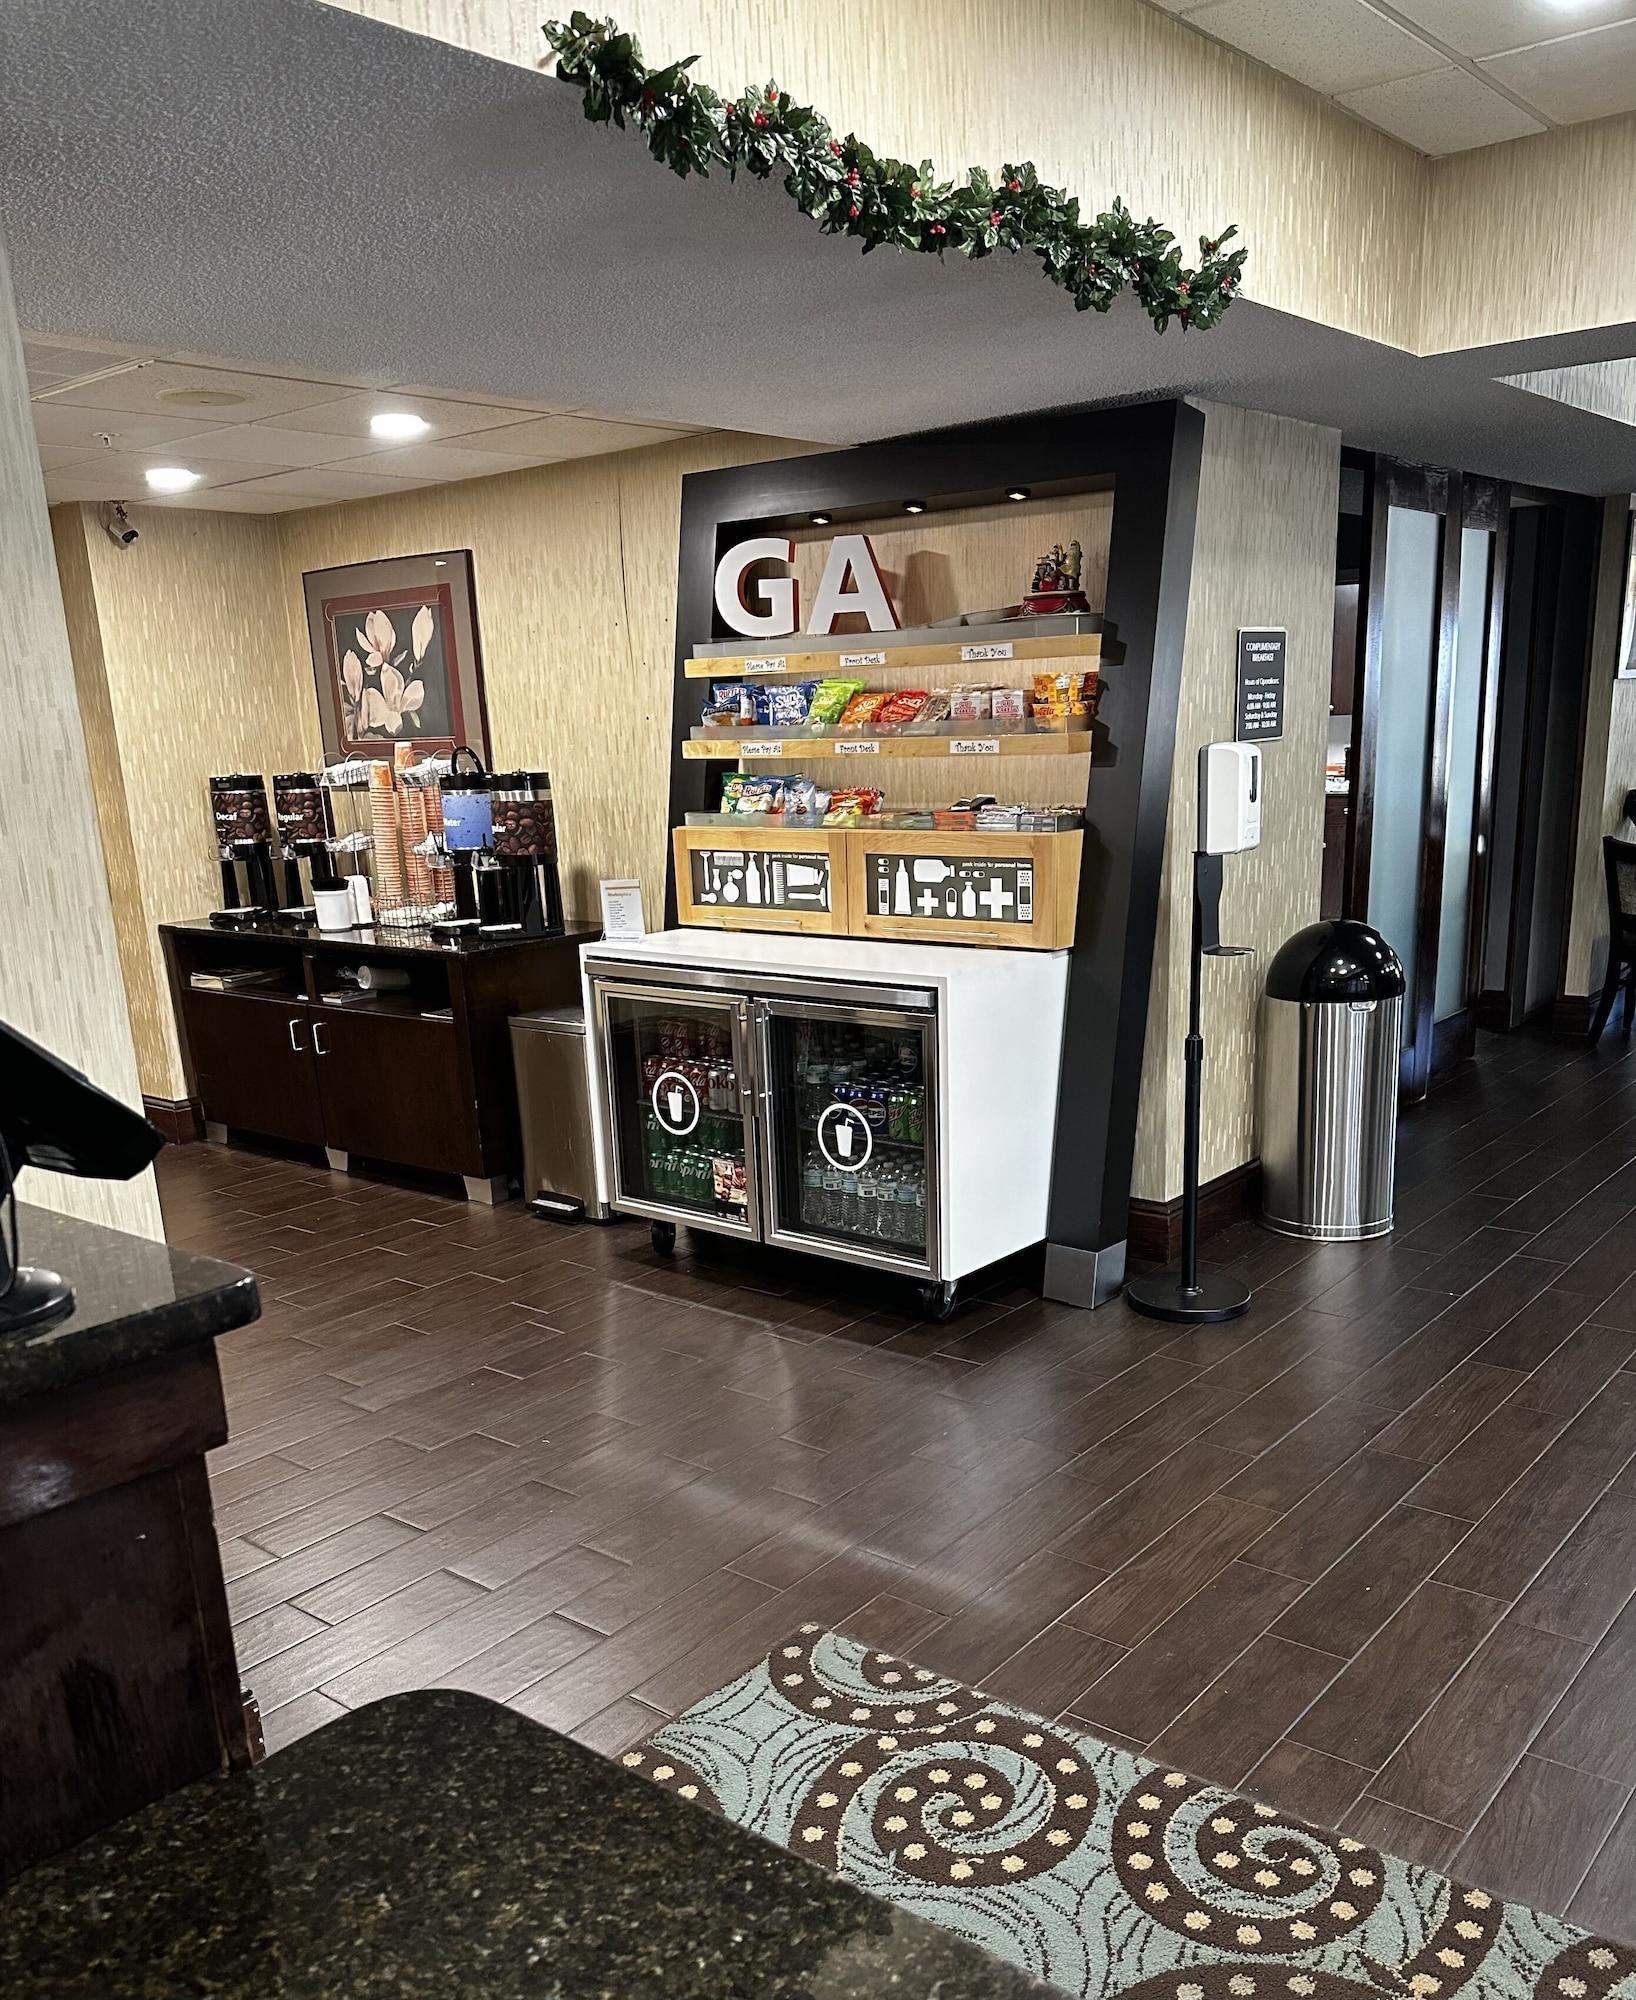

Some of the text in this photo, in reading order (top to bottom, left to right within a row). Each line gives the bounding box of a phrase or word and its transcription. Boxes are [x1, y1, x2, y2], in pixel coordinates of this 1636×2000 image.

[715, 535, 900, 637] GA
[1245, 642, 1281, 651] COMPLIMENTARY
[967, 648, 1007, 659] Thank You
[844, 654, 880, 665] Front Desk
[840, 744, 875, 753] Front Desk
[955, 742, 994, 752] Thank You
[216, 812, 237, 821] Decaf
